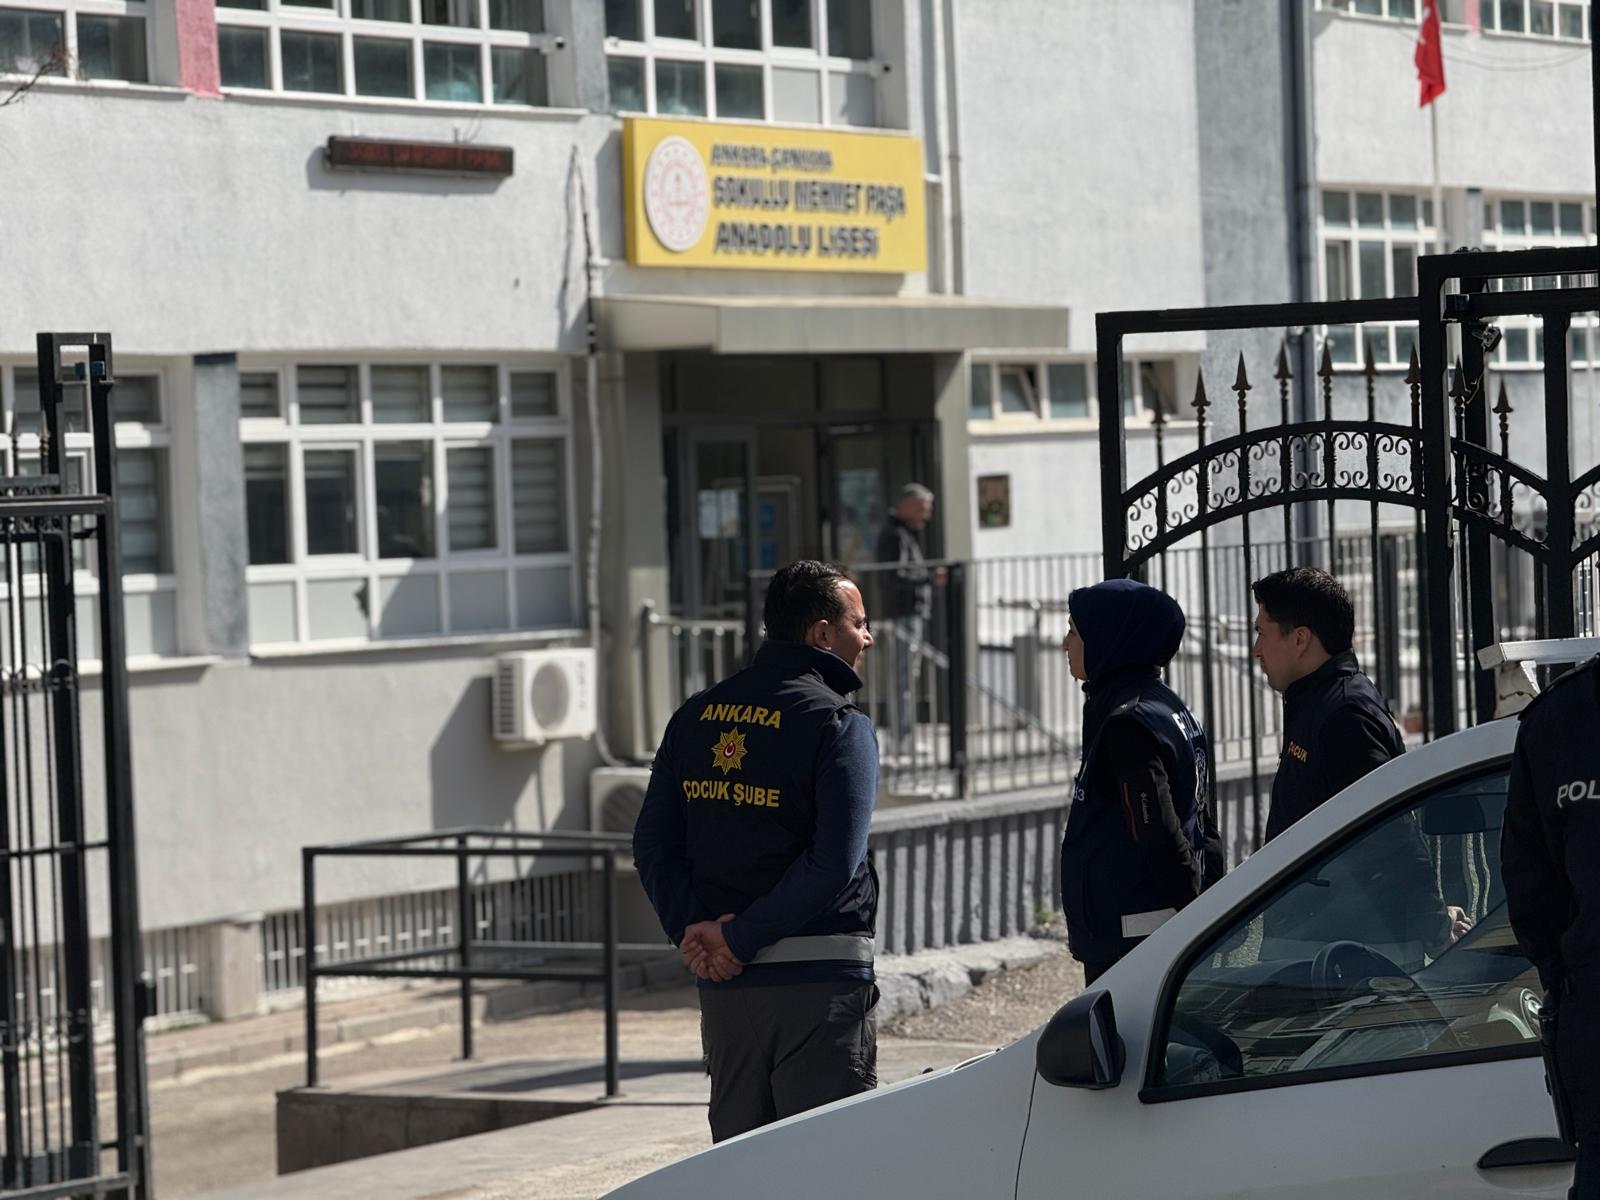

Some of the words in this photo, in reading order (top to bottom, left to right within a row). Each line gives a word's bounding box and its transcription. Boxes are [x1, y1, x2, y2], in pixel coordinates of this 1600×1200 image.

[714, 176, 789, 208] SOKULLU
[794, 181, 861, 214] MEHMET
[866, 185, 906, 223] PAŞA
[716, 221, 811, 255] ANADOLU
[700, 703, 782, 728] ANKARA
[682, 780, 730, 802] ÇOCUK
[732, 783, 781, 807] ŞUBE
